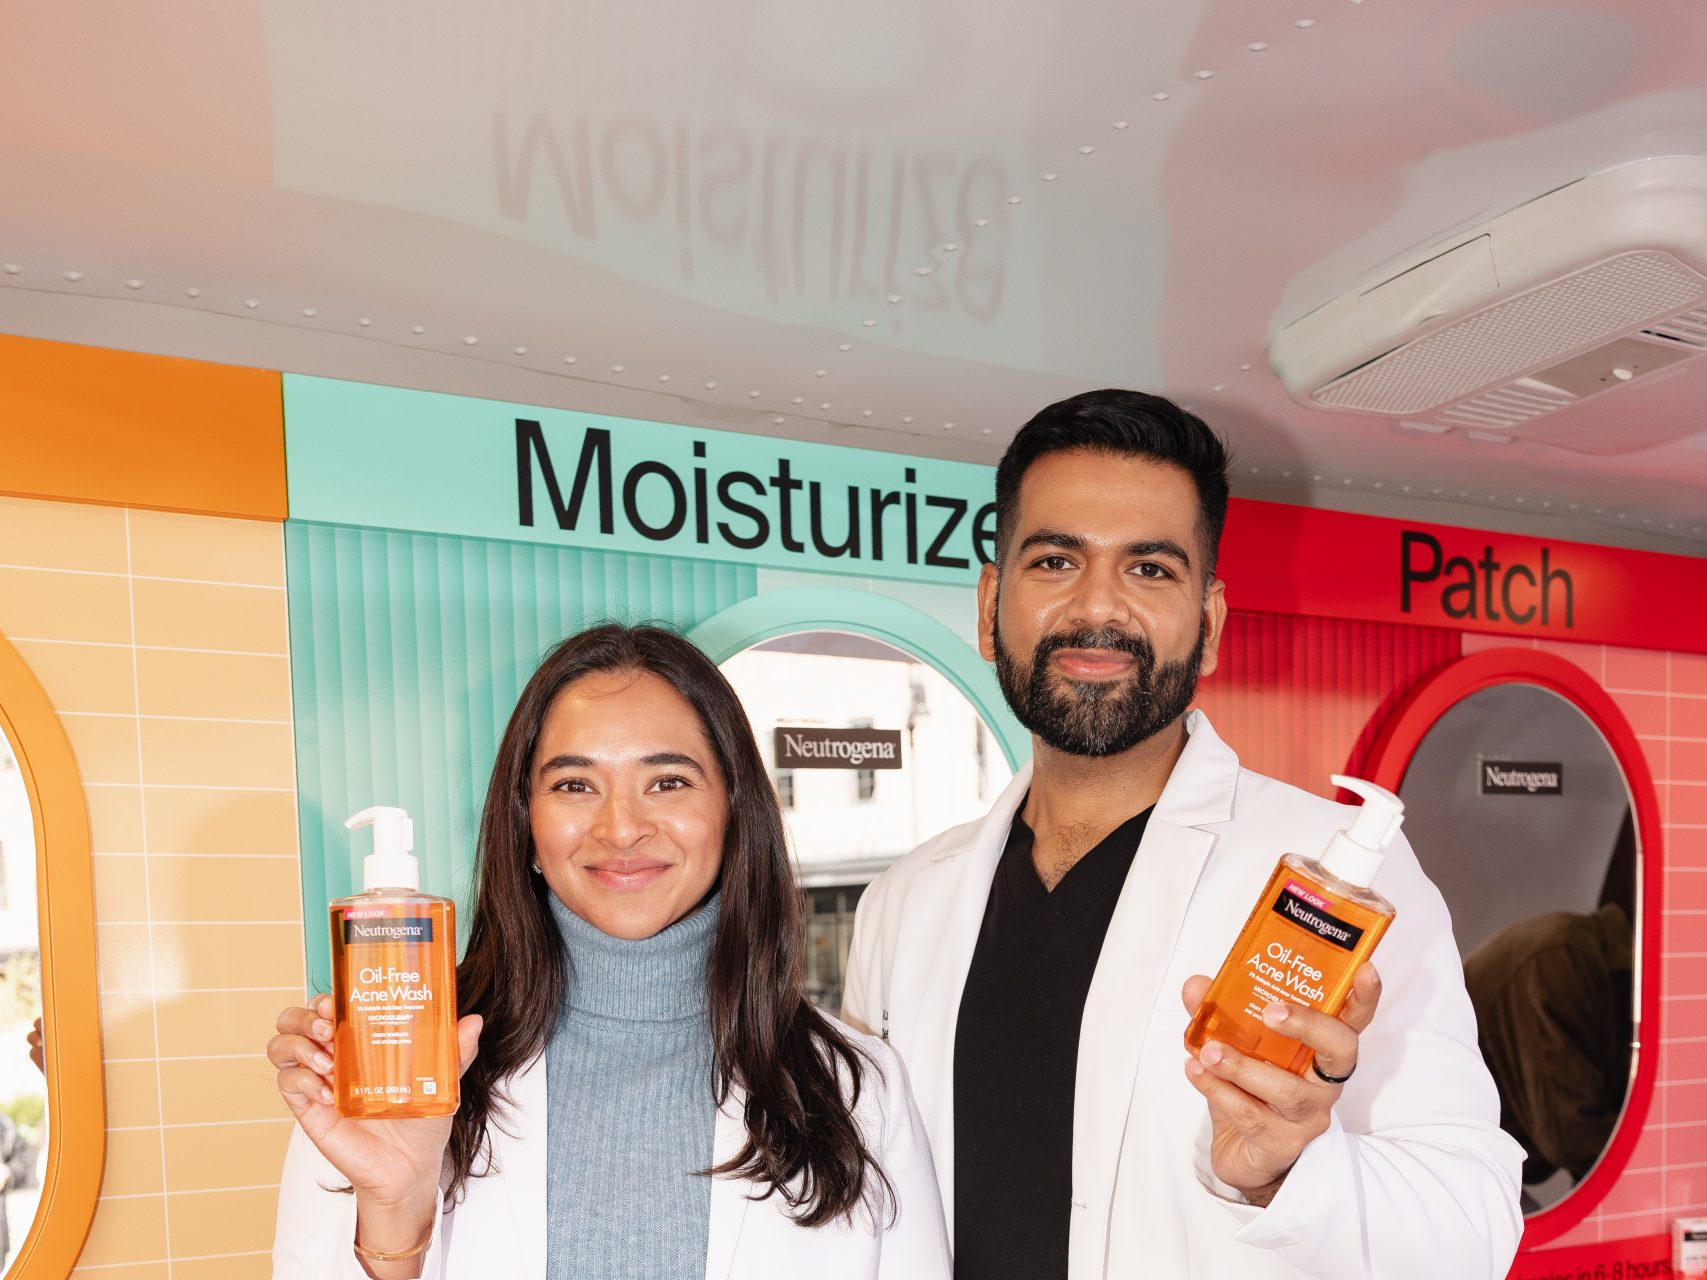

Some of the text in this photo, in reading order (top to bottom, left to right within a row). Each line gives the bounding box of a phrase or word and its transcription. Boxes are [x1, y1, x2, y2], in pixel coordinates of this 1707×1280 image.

[1401, 530, 1574, 629] Patch
[783, 734, 896, 765] Neutrogena
[1485, 766, 1558, 792] Neutrogena
[1288, 884, 1326, 908] NEW LOOK
[365, 910, 385, 918] LOOK
[1284, 899, 1350, 942] Neutrogena
[353, 925, 422, 939] Neutrogena
[360, 966, 421, 984] Oil-Free
[1267, 942, 1323, 982] Oil-Free
[1246, 953, 1325, 1003] Acne Wash
[349, 983, 433, 1003] Acne Wash
